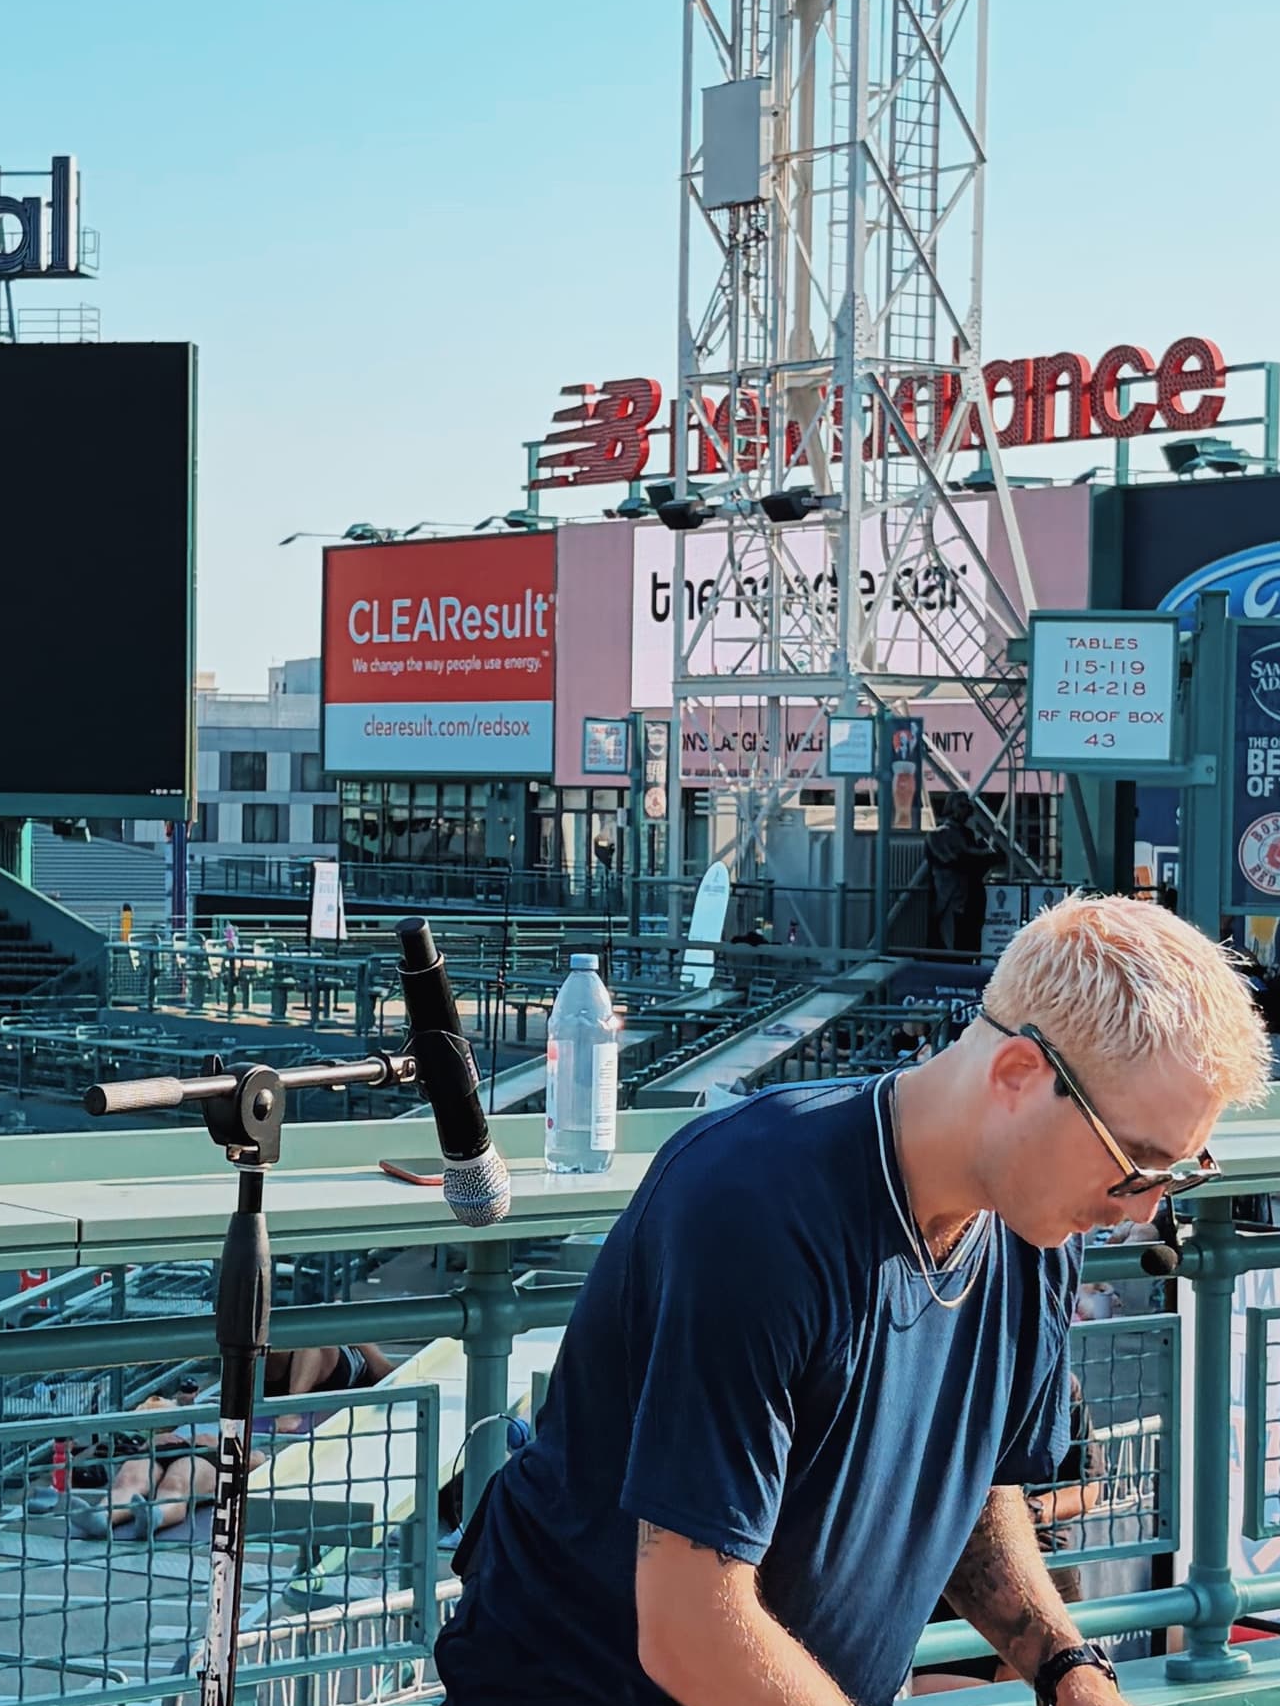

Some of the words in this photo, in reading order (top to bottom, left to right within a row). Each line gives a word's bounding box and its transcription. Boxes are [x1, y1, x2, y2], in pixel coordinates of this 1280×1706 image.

[1066, 637, 1138, 650] TABLES
[1064, 660, 1145, 674] 115-119
[1057, 680, 1146, 695] 214-218
[1038, 710, 1061, 722] RF
[1070, 710, 1120, 723] ROOF
[1128, 711, 1164, 723] BOX
[364, 713, 530, 737] clearesult.com/redsox
[1084, 733, 1116, 748] 43
[1248, 736, 1268, 749] THE
[1246, 776, 1274, 798] OF
[1248, 863, 1276, 888] RED
